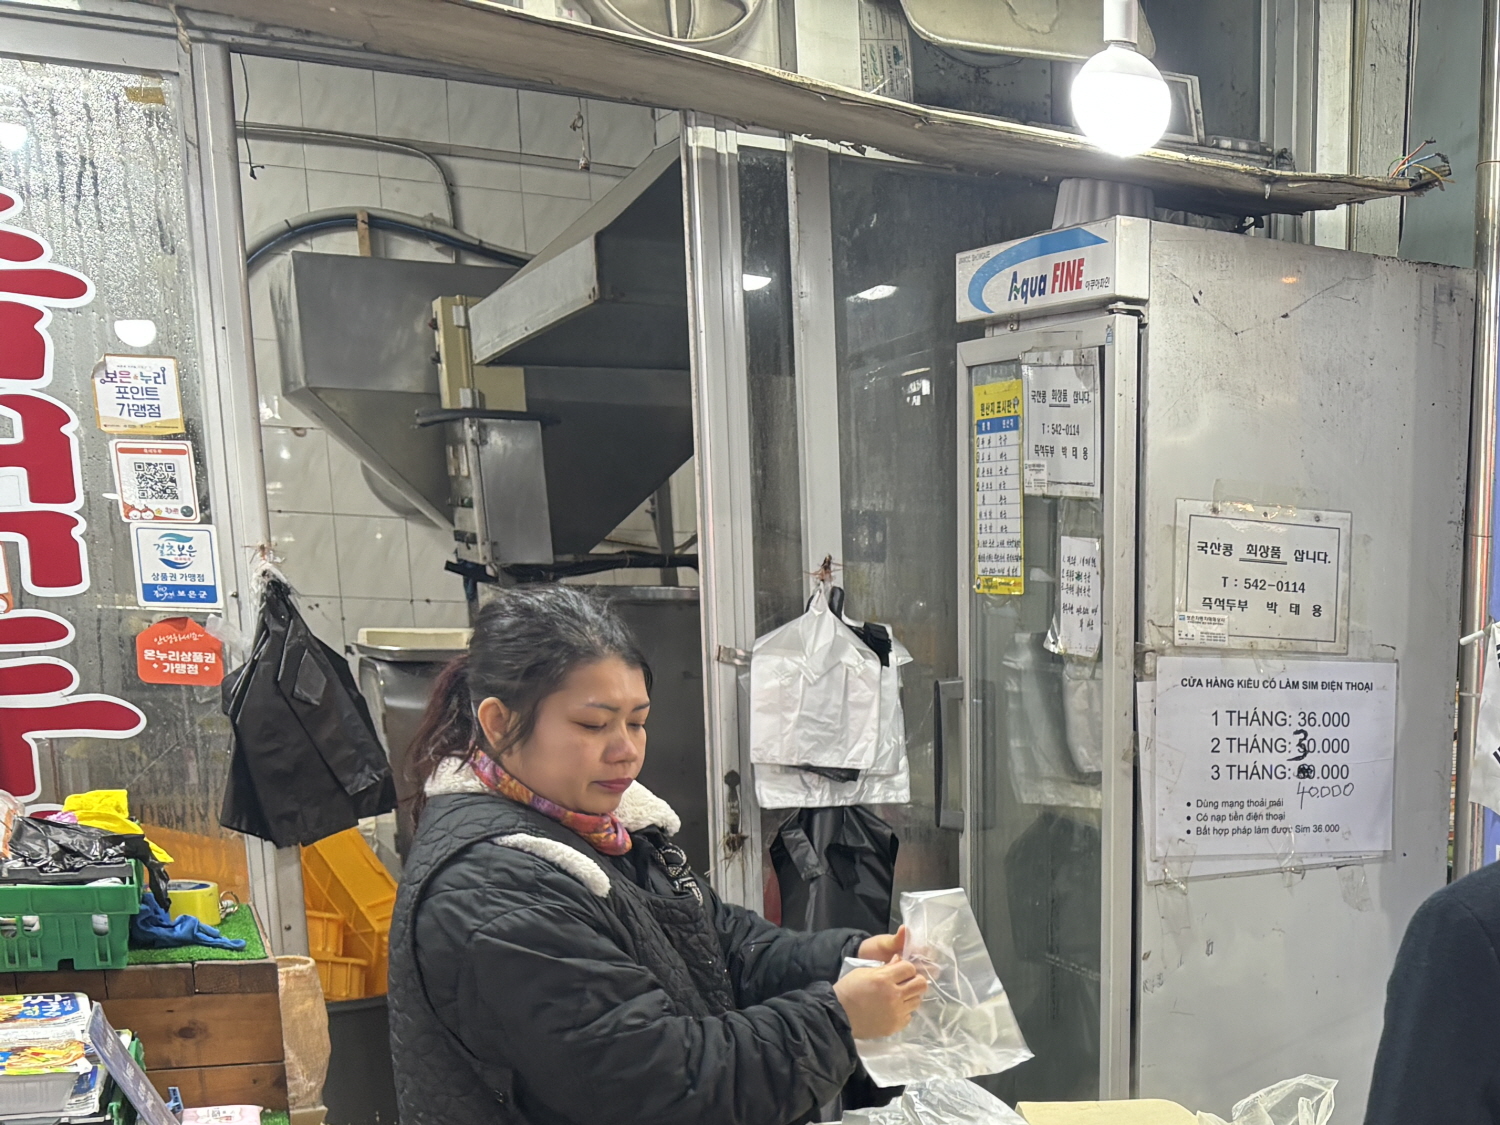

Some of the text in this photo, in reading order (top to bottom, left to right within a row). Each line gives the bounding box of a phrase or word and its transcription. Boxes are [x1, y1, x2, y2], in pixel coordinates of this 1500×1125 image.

[1008, 258, 1085, 304] Aqua FINE
[1085, 277, 1110, 290] 아쿠아파인
[101, 367, 167, 385] 보은 누리
[115, 386, 160, 401] 포인트
[1031, 390, 1047, 403] 국산콩
[1051, 389, 1068, 403] 최상품
[116, 403, 161, 418] 가맹점
[1051, 424, 1080, 436] 542-0114
[153, 543, 197, 557] 결초보은
[1197, 541, 1331, 564] 국산콩 최상품 삽니다.
[151, 573, 205, 582] 상품권 가맹점
[1243, 578, 1306, 593] 542-0114
[1202, 597, 1248, 612] 즉석두부
[143, 649, 216, 664] 온누리상품권
[162, 663, 199, 675] 가맹점
[1206, 677, 1234, 689] HÀNG
[1279, 678, 1300, 690] LÀM
[1302, 681, 1319, 690] SIM
[1321, 678, 1342, 692] ĐIỆN
[1345, 682, 1373, 693] THOẠI
[1211, 707, 1350, 727] 1 THÁNG: 36.000
[1211, 738, 1220, 753] 2
[1226, 734, 1292, 754] THÁNG:
[1211, 765, 1220, 780] 3
[1226, 761, 1292, 780] THÁNG:
[1196, 812, 1208, 822] Có
[1211, 814, 1226, 824] nạp
[1245, 811, 1263, 822] điện
[1266, 812, 1285, 822] thoại
[1212, 826, 1229, 837] hợp
[1232, 825, 1252, 837] pháp
[1294, 825, 1311, 834] Sim
[1313, 824, 1340, 833] 36.000
